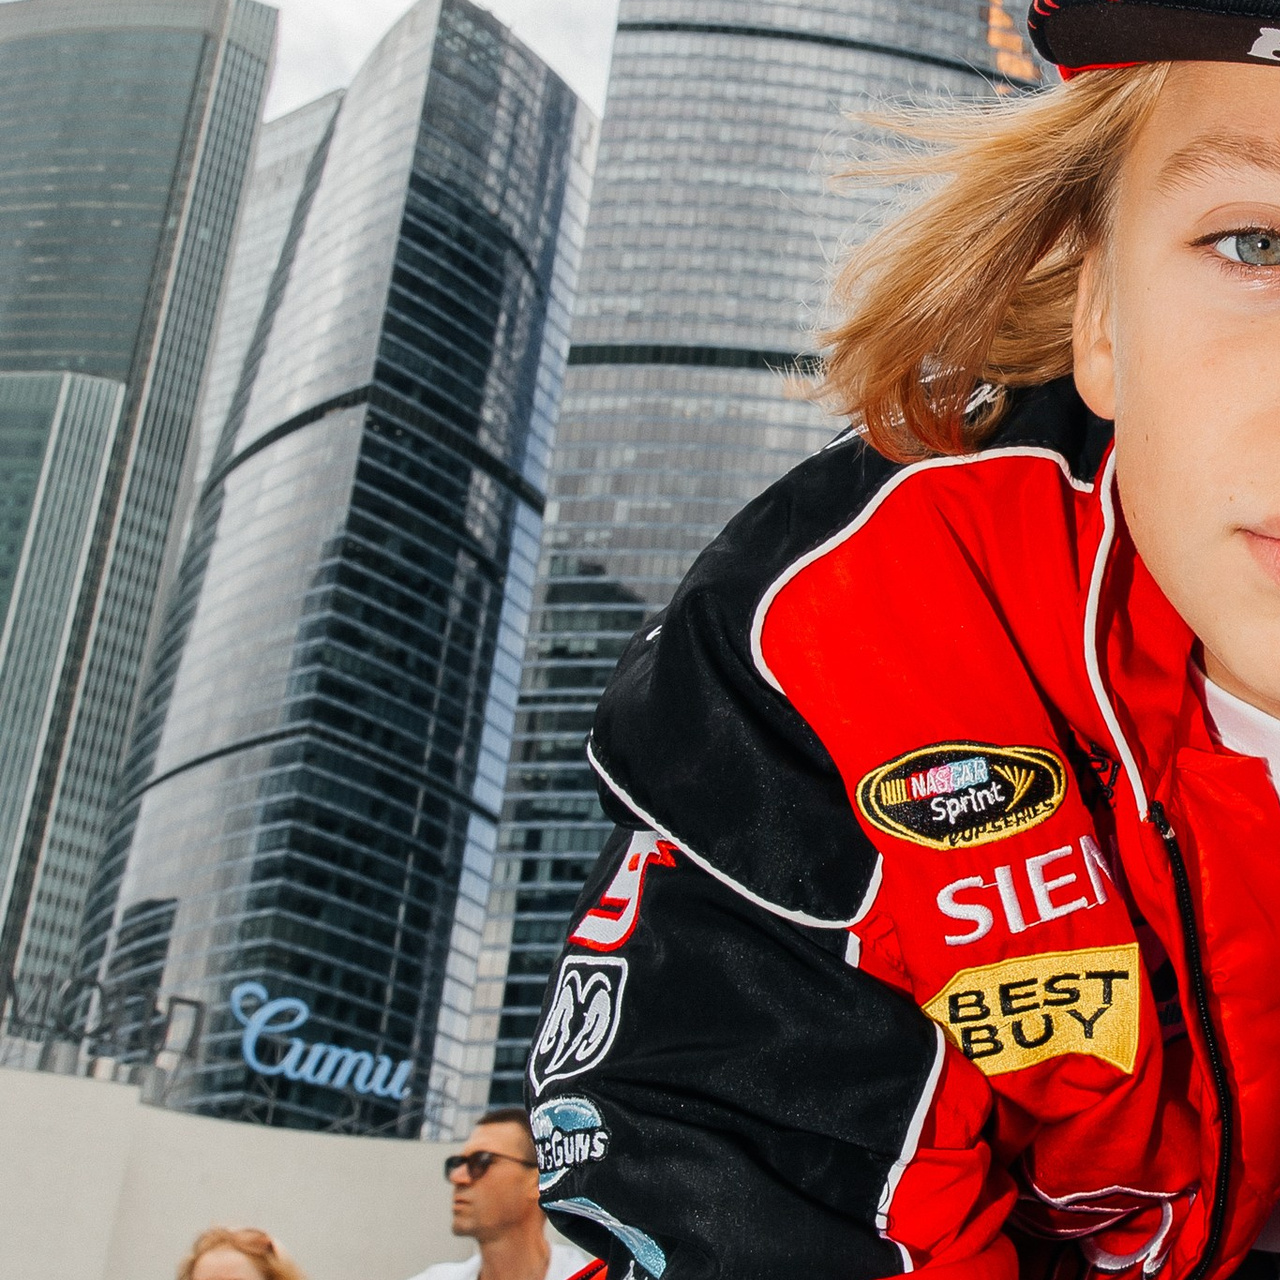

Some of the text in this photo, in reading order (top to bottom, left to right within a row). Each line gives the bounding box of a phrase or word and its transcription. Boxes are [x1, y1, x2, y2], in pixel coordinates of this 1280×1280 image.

[909, 758, 989, 800] NASCAR
[930, 781, 1006, 824] Sprint
[948, 970, 1130, 1025] BEST
[961, 1006, 1109, 1060] BUY
